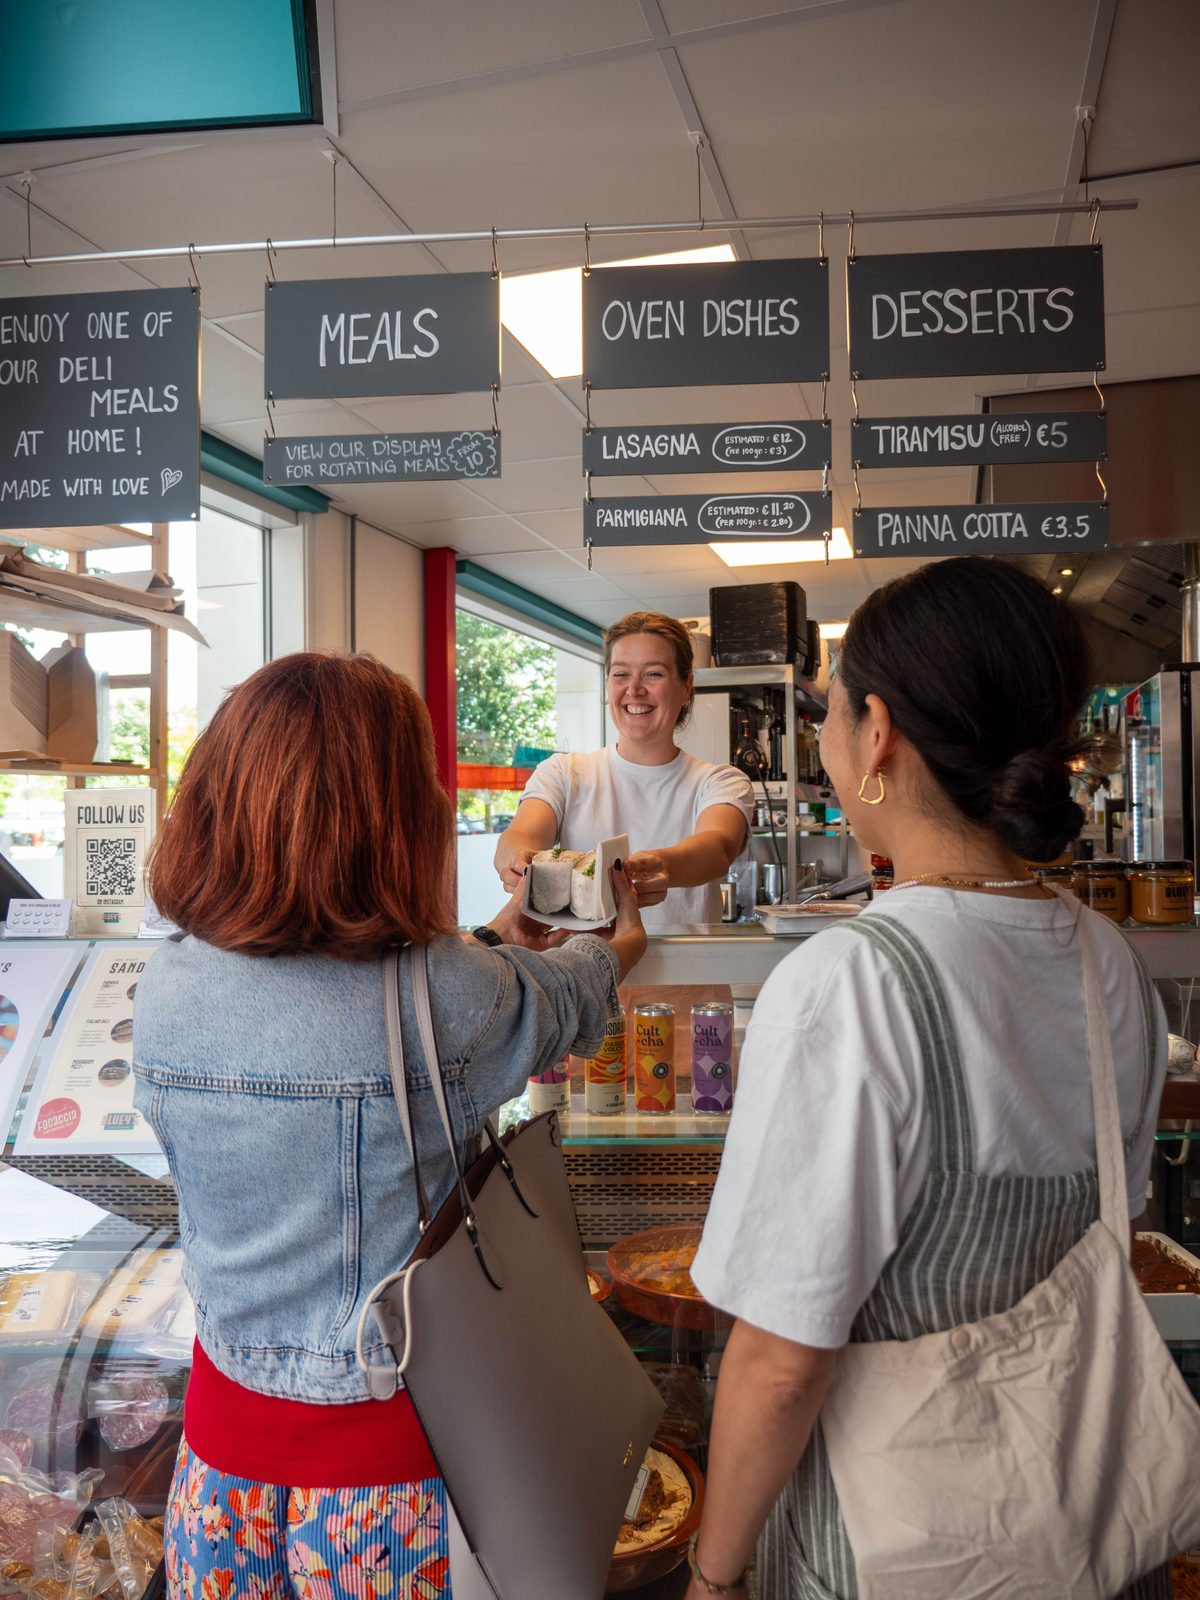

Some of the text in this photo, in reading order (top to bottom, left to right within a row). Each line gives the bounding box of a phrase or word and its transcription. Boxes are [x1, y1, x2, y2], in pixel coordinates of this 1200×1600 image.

[1, 311, 173, 344] ENJOY ONE OF
[601, 297, 800, 341] OVEN DISHES
[871, 287, 1075, 340] DESSERTS
[319, 307, 440, 368] MEALS
[0, 356, 112, 385] OUR DELI
[90, 384, 180, 418] MEALS
[14, 430, 45, 458] AT
[68, 428, 126, 455] HOME
[285, 435, 442, 461] VIEW OUR DISPLAY
[457, 440, 481, 458] FROM
[602, 432, 701, 460] LASAGNA
[871, 423, 985, 455] TIRAMISU
[286, 457, 450, 479] FOR ROTATING MEALS
[466, 451, 483, 470] 10
[1, 477, 150, 501] MADE WITH LOVE
[596, 508, 688, 528] PARMIGIANA
[877, 511, 1090, 547] PANNA COTTA €3.5
[77, 804, 145, 825] FOLLOW US
[636, 1024, 660, 1036] Cult
[694, 1024, 718, 1036] Cult
